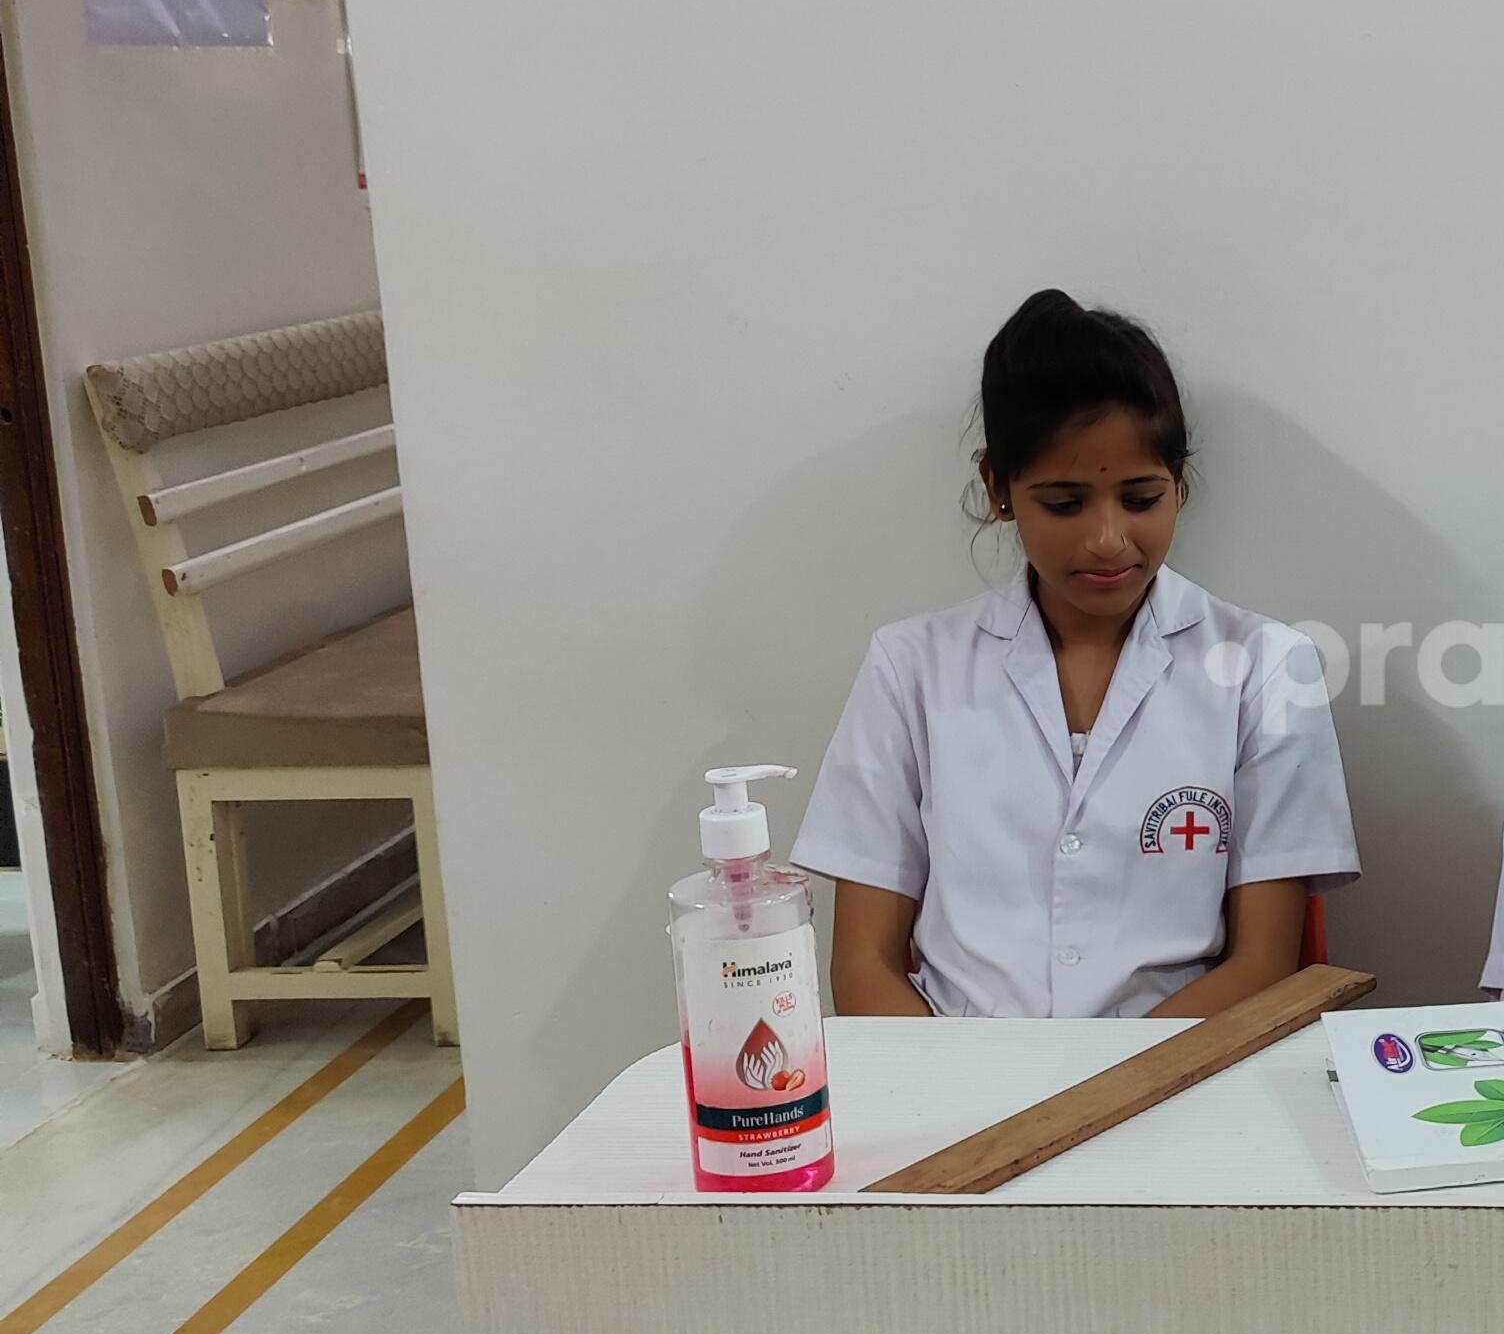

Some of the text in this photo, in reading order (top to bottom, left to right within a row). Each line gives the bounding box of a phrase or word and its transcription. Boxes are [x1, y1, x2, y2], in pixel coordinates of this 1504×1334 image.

[1143, 794, 1178, 849] SAVITRIBAI
[1178, 789, 1209, 804] FULE
[722, 959, 793, 979] Himalaya
[723, 979, 761, 989] SINCE
[731, 1105, 805, 1128] PureHands
[737, 1125, 801, 1142] STRAWBERRY
[739, 1142, 803, 1159] Hand Sanitizer
